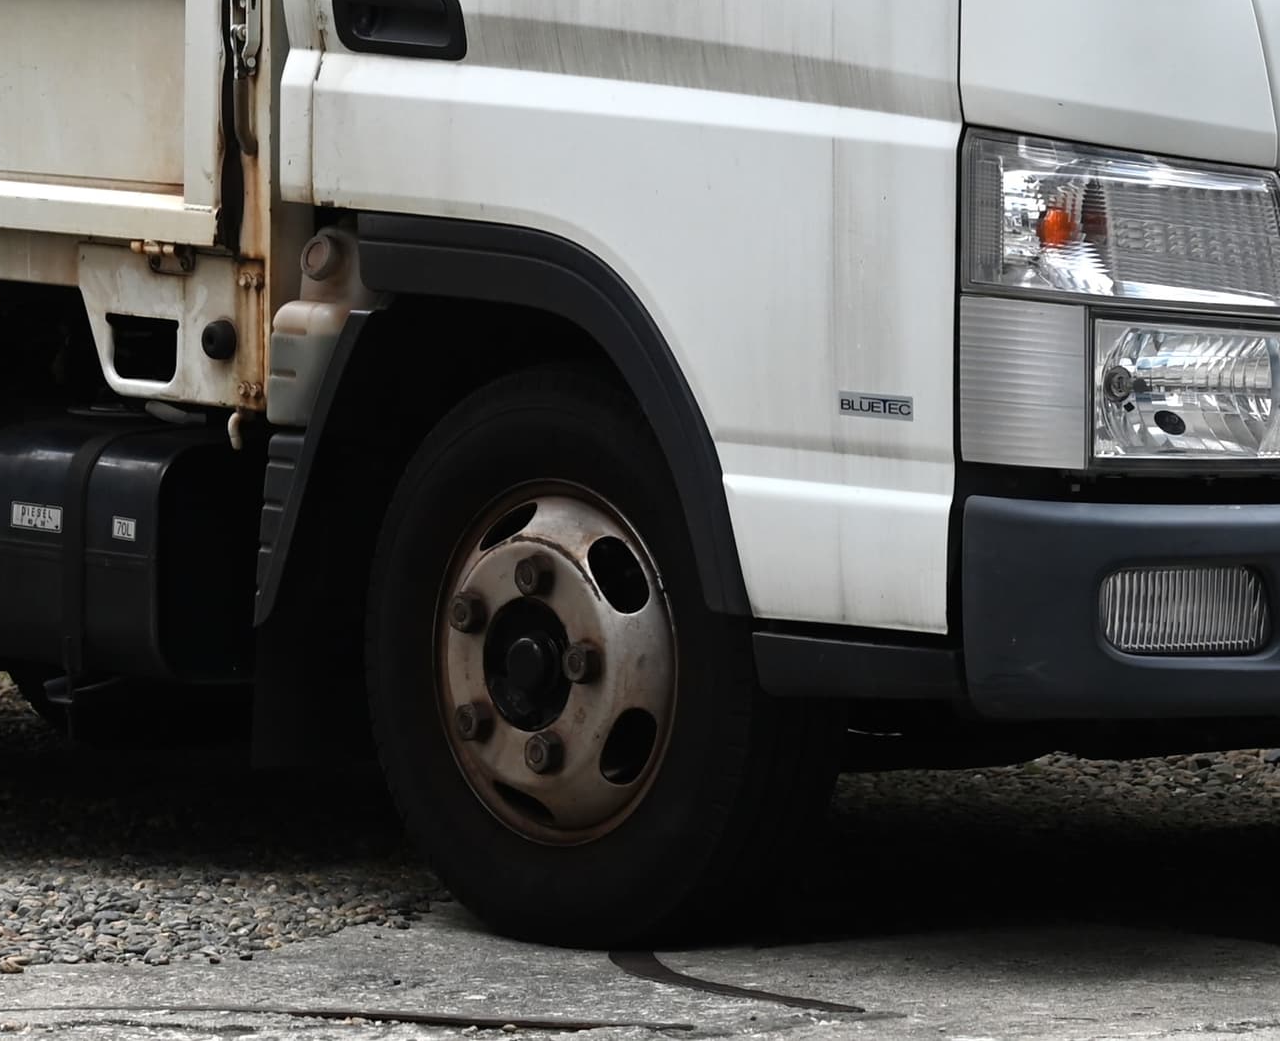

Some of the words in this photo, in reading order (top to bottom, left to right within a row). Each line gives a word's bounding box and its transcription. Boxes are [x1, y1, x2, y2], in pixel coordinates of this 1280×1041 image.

[840, 396, 912, 416] BLUETEC
[21, 506, 53, 520] DIESEL
[116, 521, 132, 537] 70L
